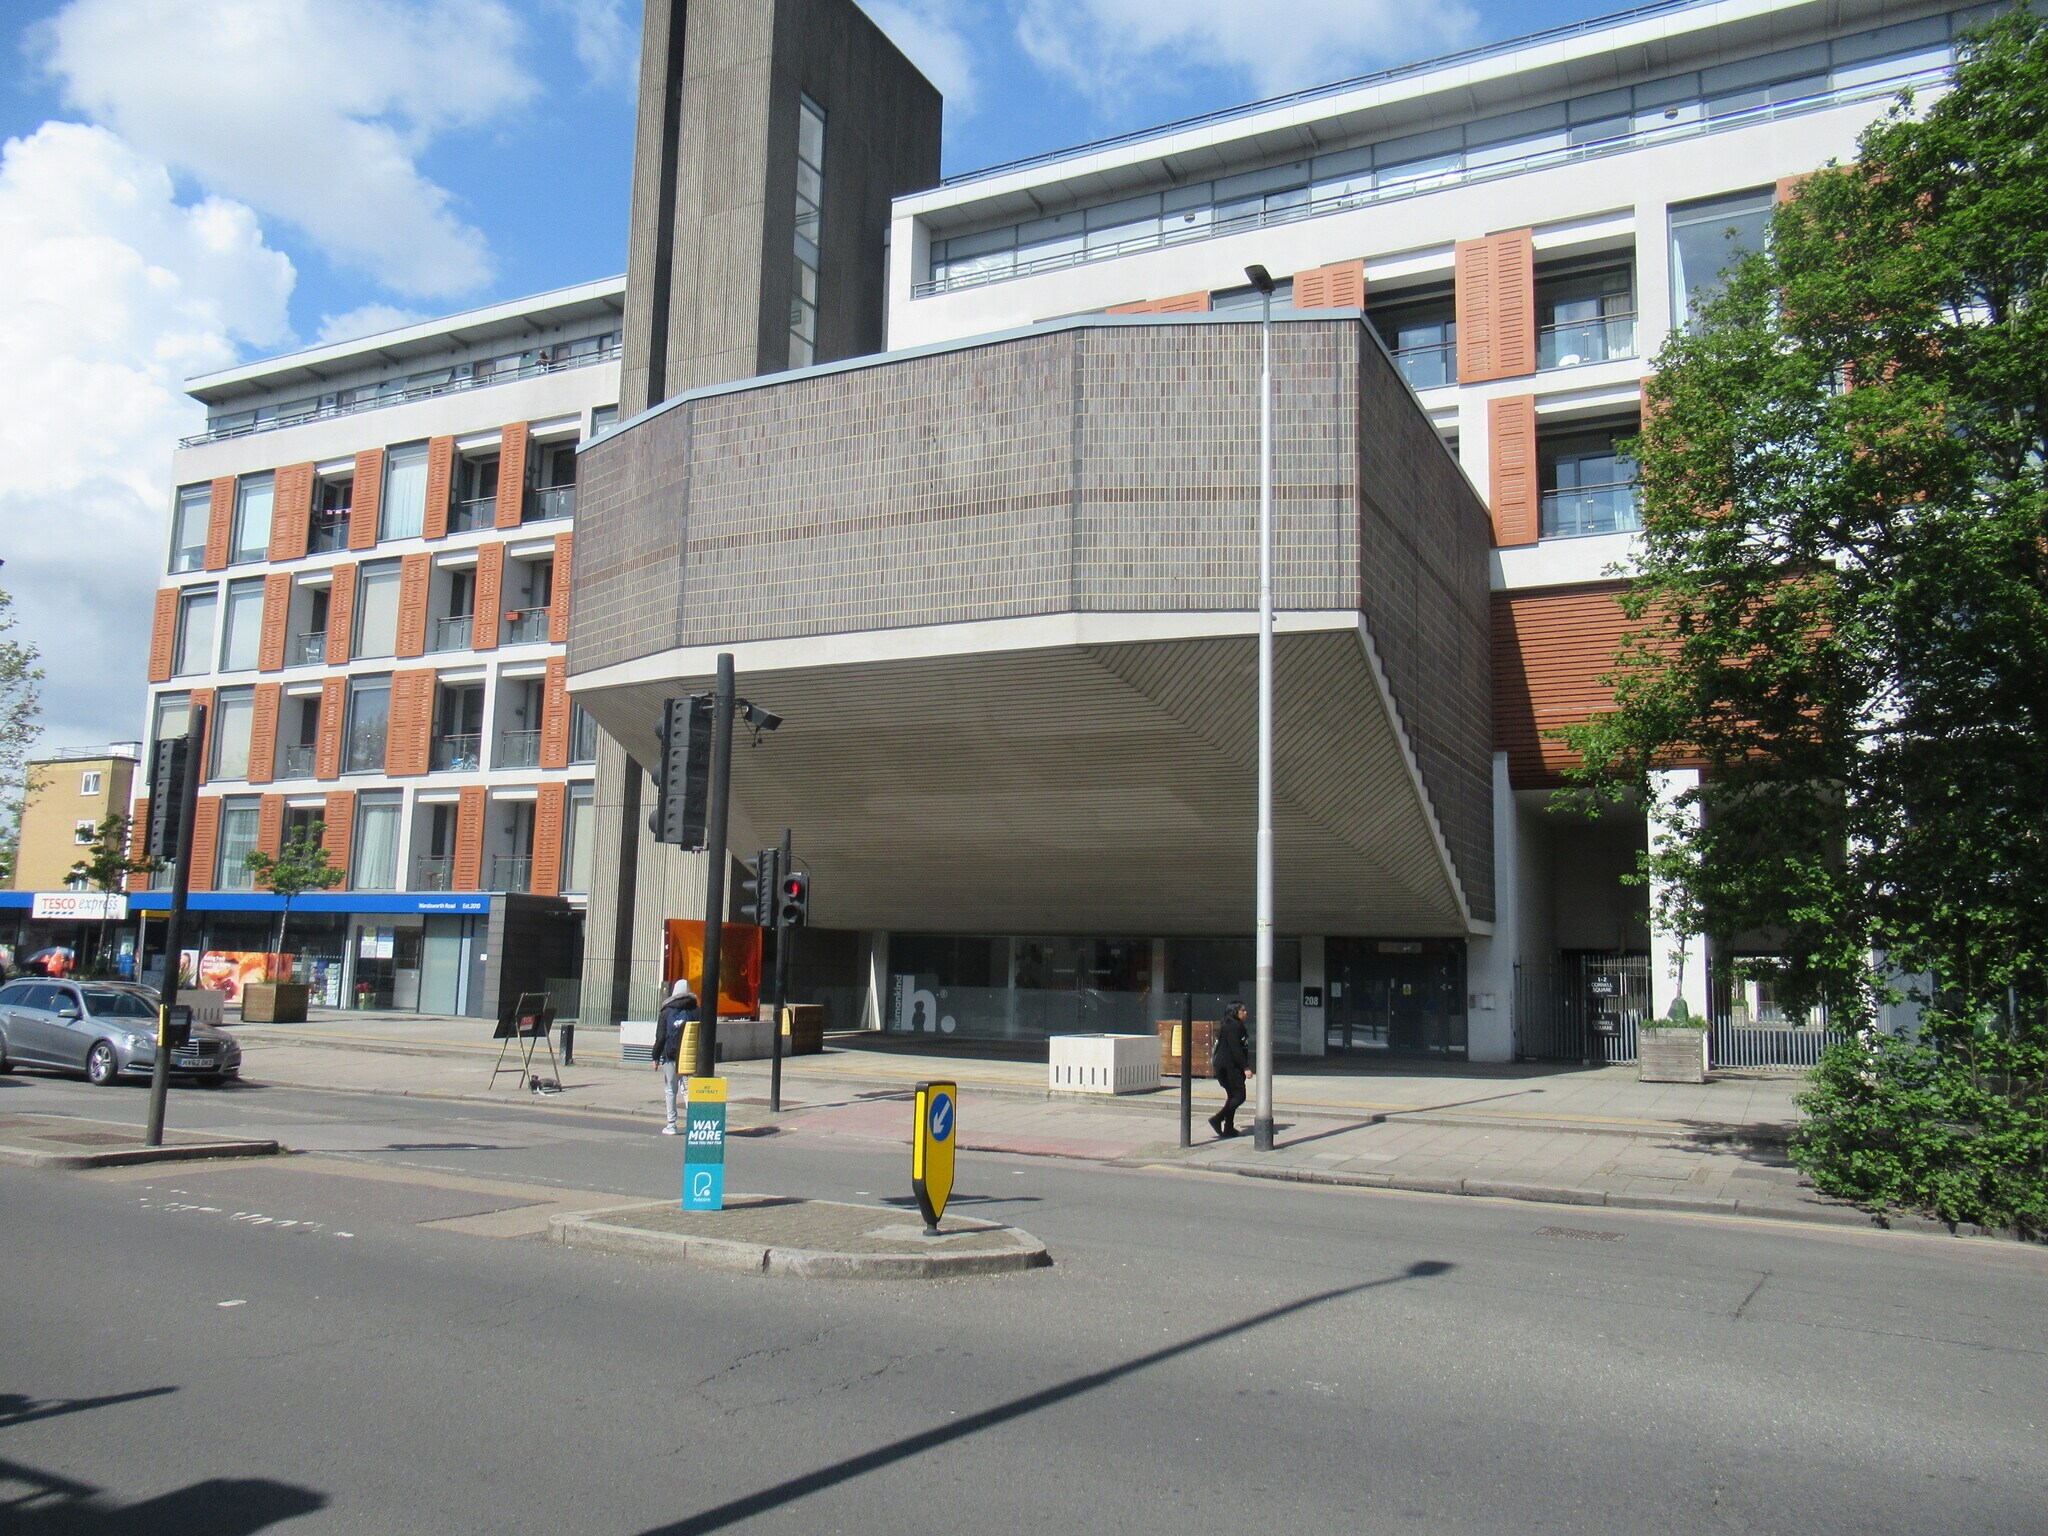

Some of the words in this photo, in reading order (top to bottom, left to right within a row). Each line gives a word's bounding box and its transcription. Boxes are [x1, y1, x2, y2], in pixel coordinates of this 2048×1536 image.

[42, 898, 76, 909] TESCO
[893, 974, 902, 1030] humankind
[1304, 996, 1319, 1006] 208
[693, 1120, 719, 1130] WAY
[688, 1130, 722, 1140] MORE
